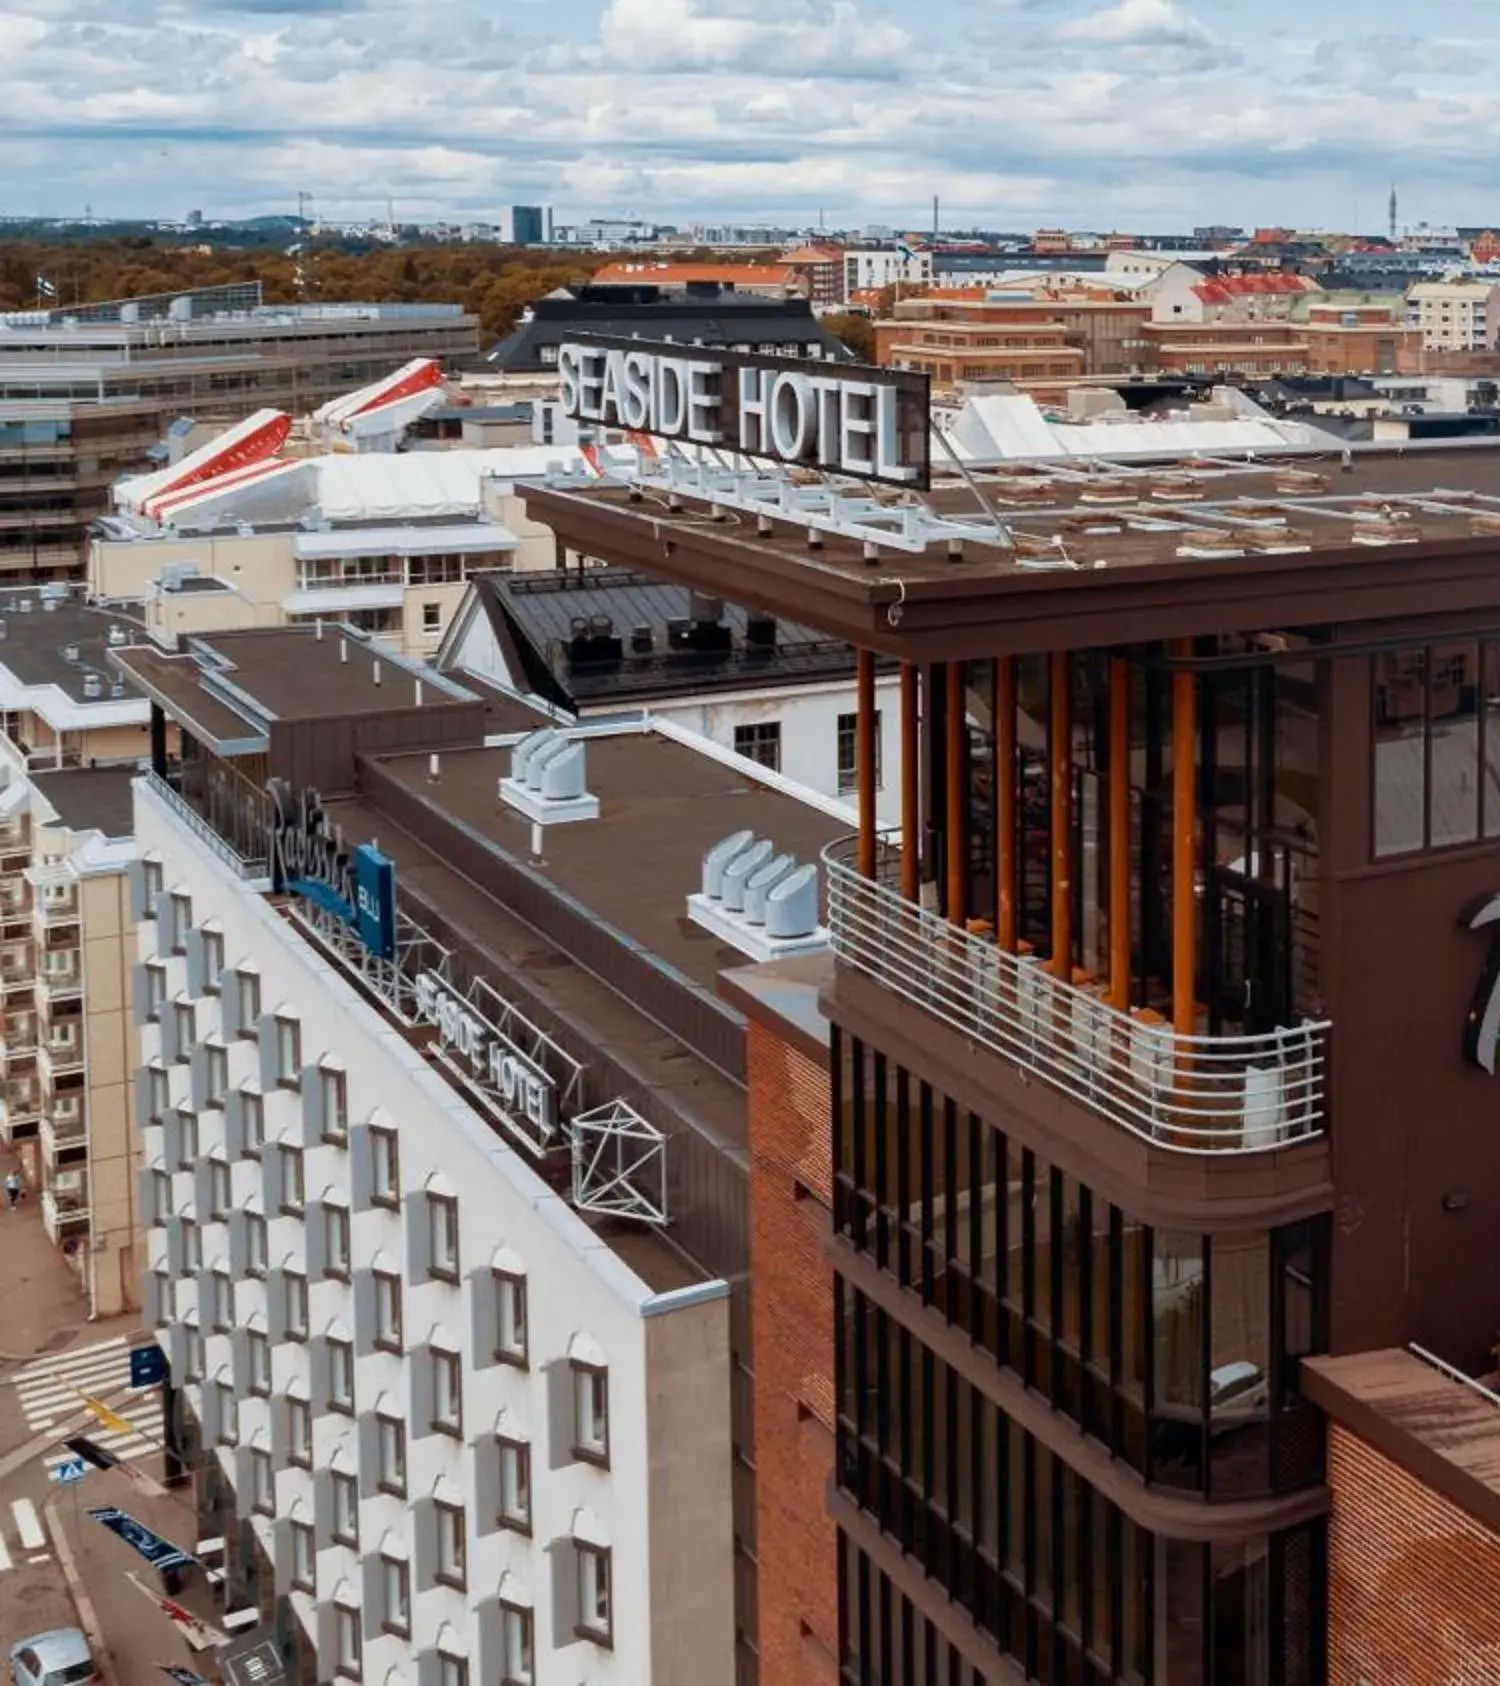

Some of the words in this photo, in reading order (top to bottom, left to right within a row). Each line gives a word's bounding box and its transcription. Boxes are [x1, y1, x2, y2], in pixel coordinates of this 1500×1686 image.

[559, 343, 723, 443] SEASIDE
[738, 367, 918, 481] HOTEL
[489, 1041, 556, 1134] HOTEL
